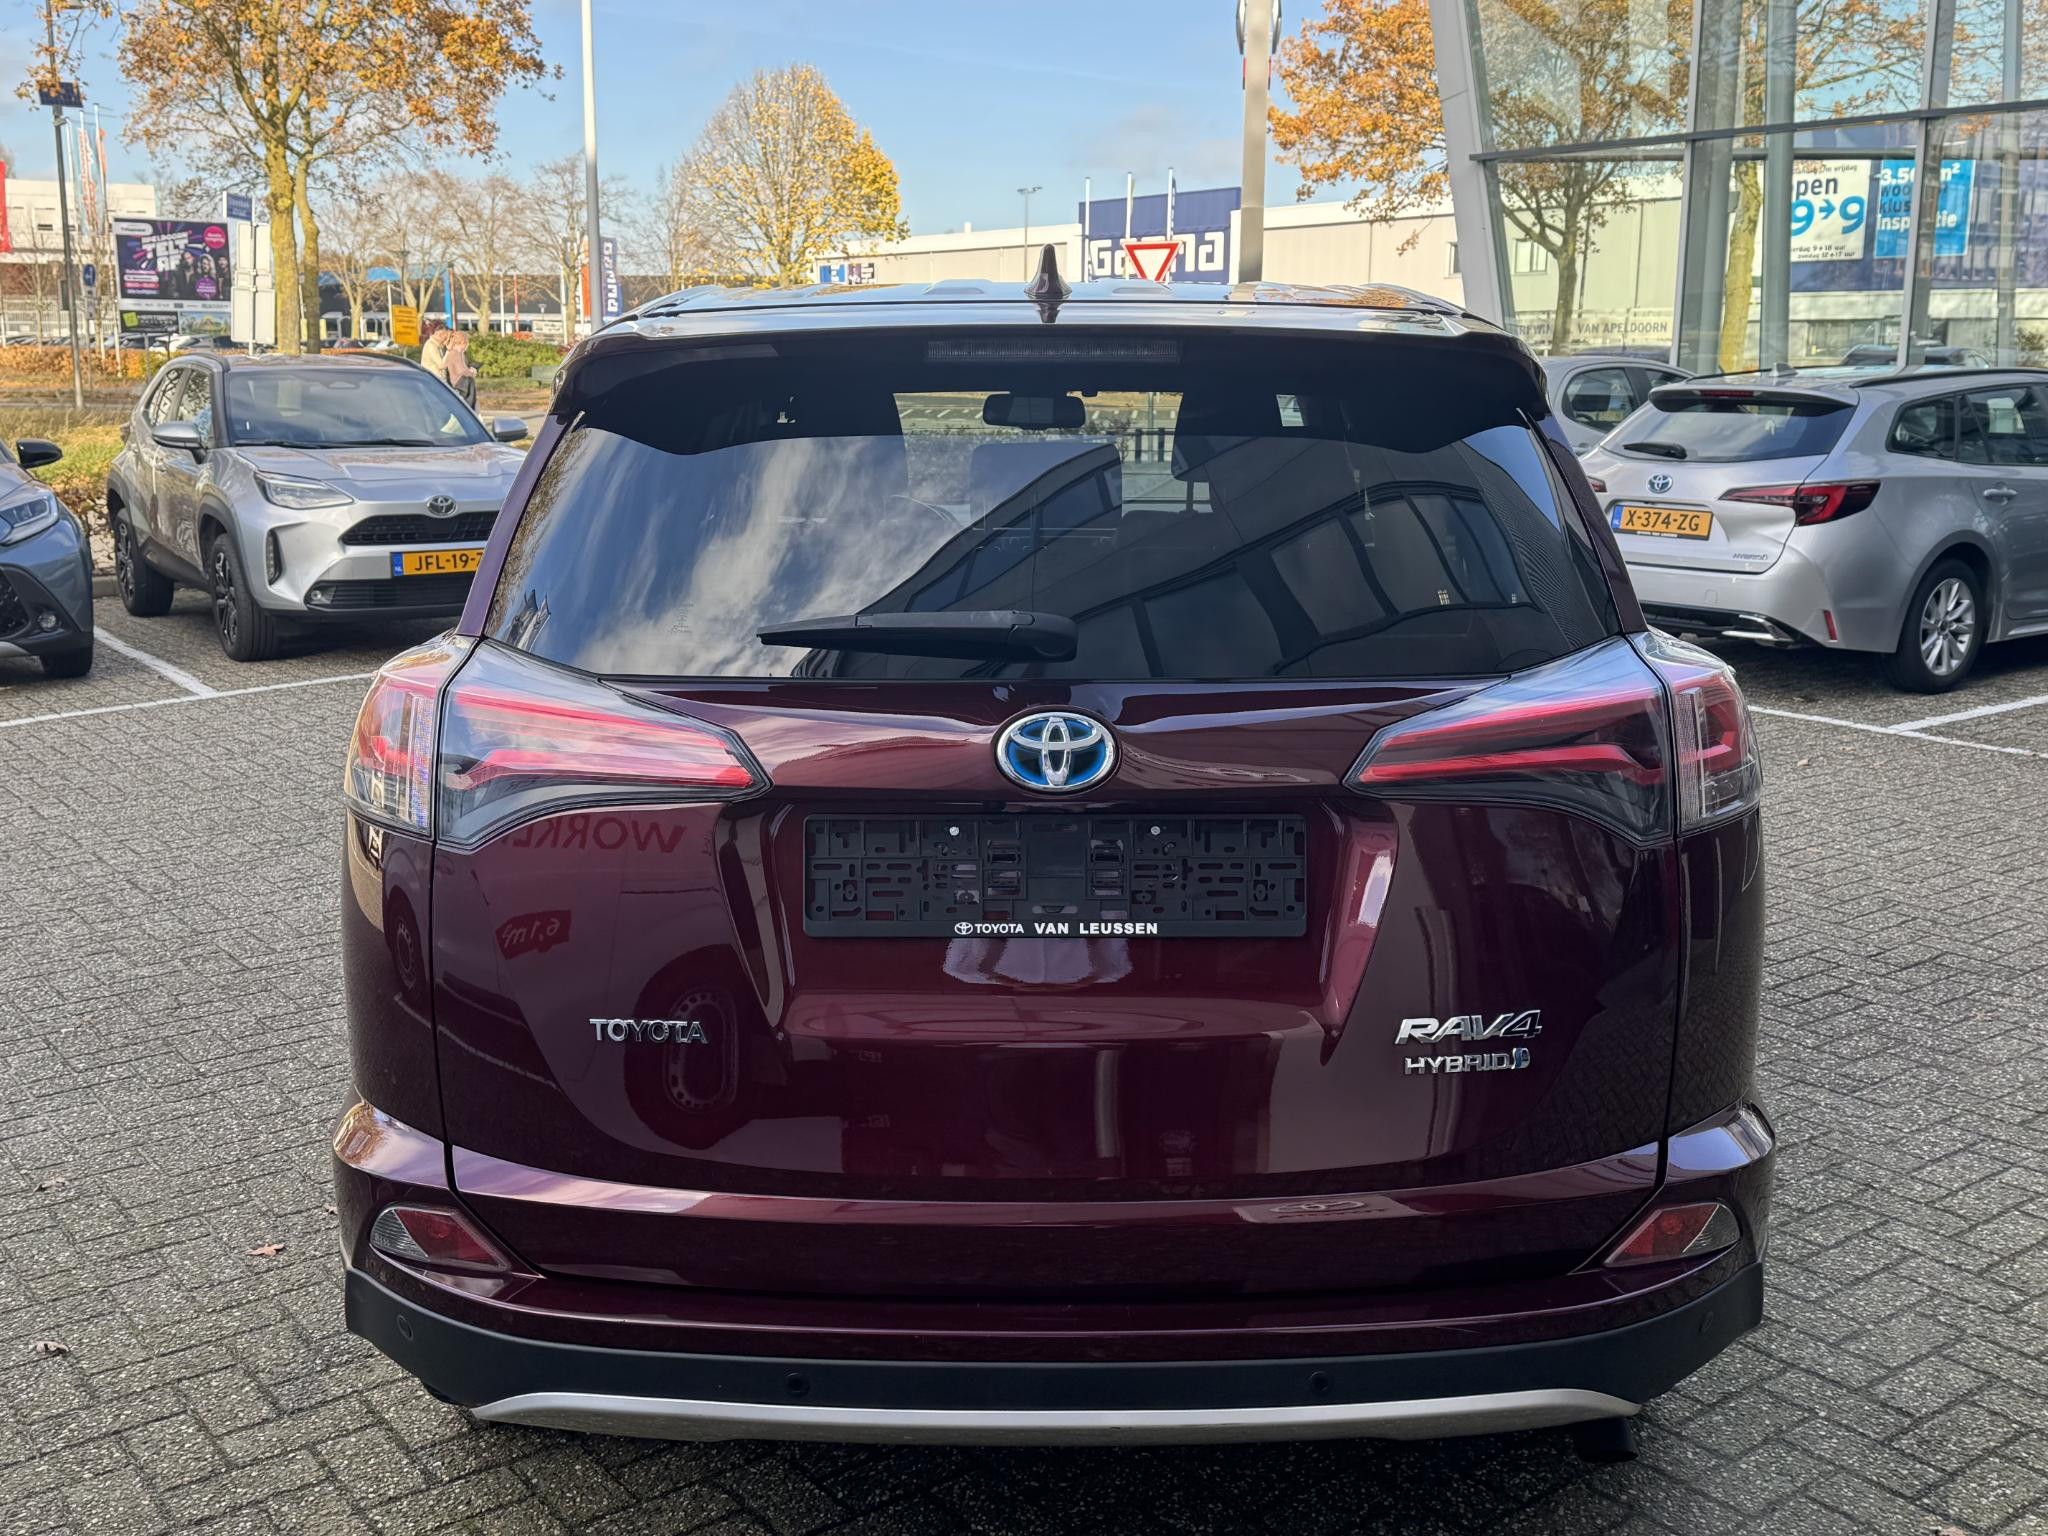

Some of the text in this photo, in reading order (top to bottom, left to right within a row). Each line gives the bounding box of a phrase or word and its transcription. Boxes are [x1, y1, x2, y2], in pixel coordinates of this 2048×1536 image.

[1793, 177, 1838, 201] pen
[1880, 184, 1912, 197] woo
[1792, 195, 1865, 236] 9 9
[1577, 322, 1667, 334] VAN APELDOORN
[1625, 509, 1700, 532] X-374-ZG
[974, 922, 1158, 935] TOYOTA VAN LEUSSEN
[588, 1018, 709, 1044] TOYOTA
[1395, 1009, 1543, 1044] RAV4
[1404, 1053, 1512, 1075] HYBRID
